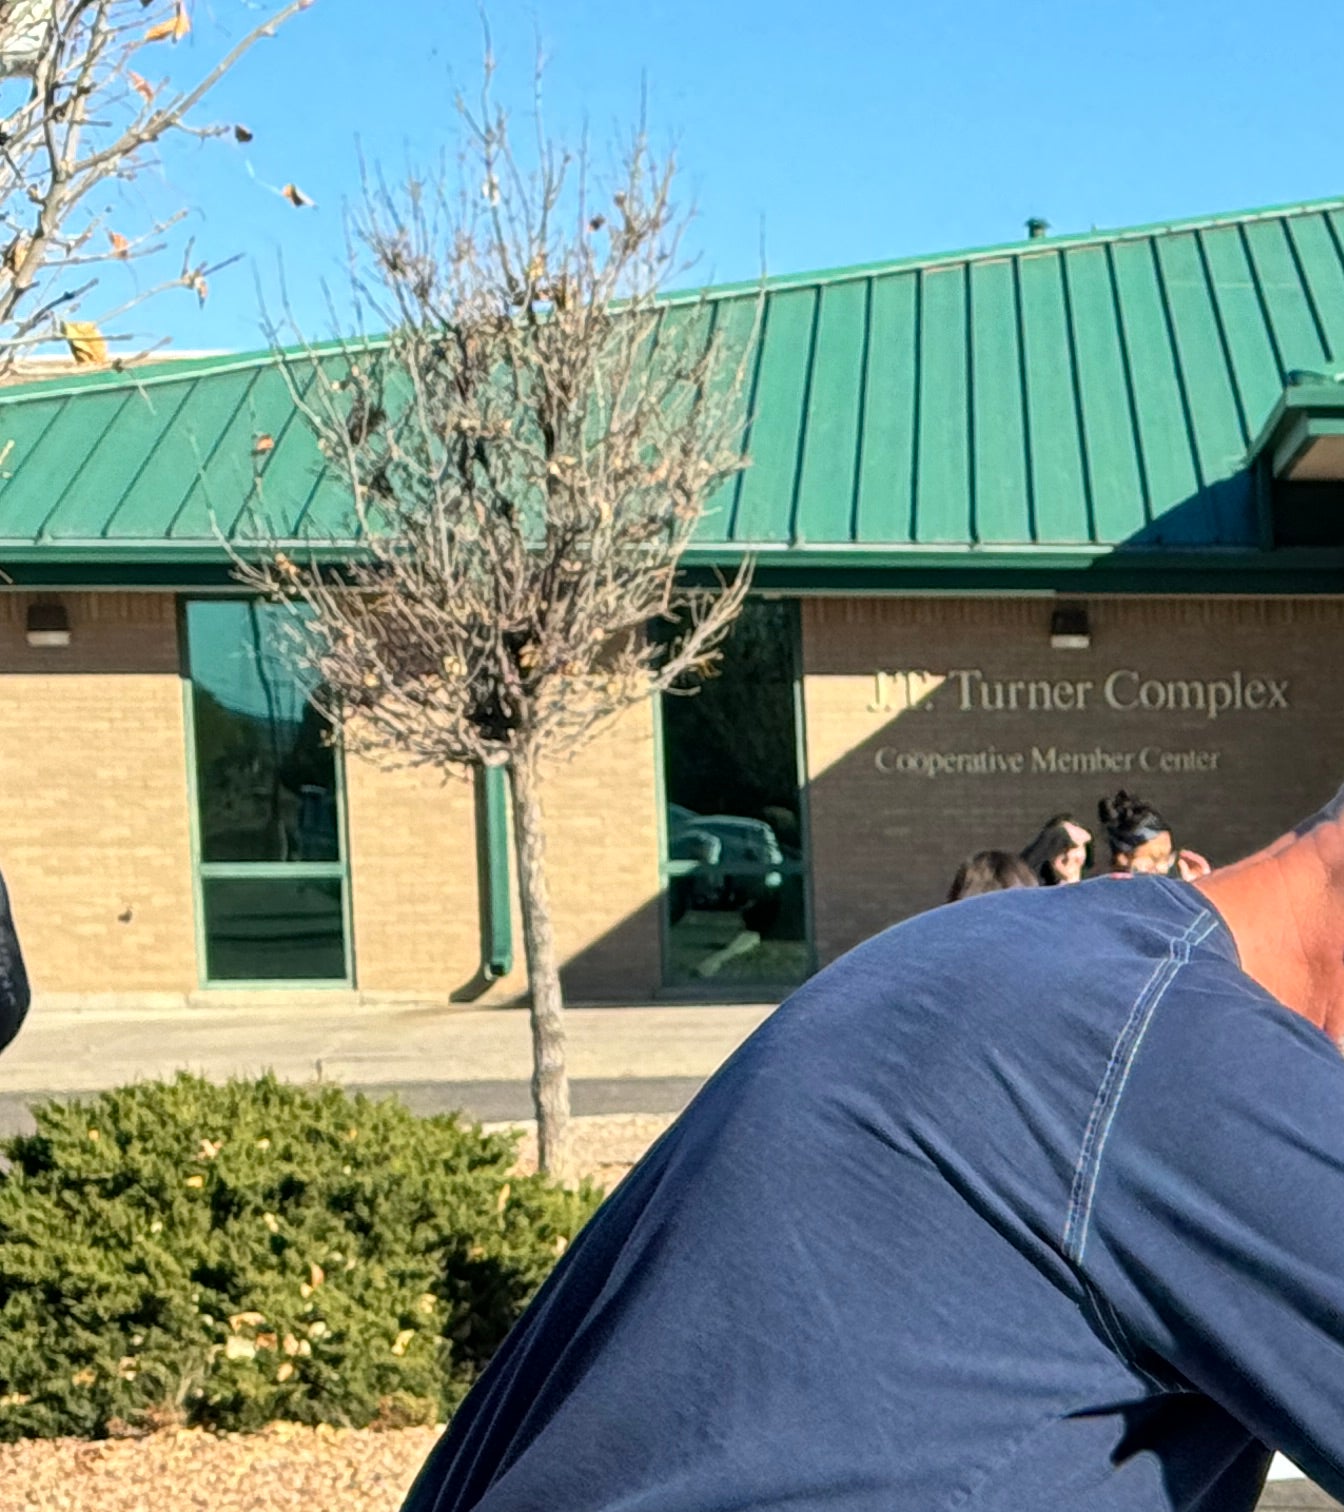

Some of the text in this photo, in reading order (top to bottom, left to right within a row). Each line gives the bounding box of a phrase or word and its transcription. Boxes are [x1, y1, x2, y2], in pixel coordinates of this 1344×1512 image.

[949, 669, 1093, 711] Turner
[1104, 669, 1288, 719] Complex
[874, 745, 1221, 778] Cooperative Member Center
